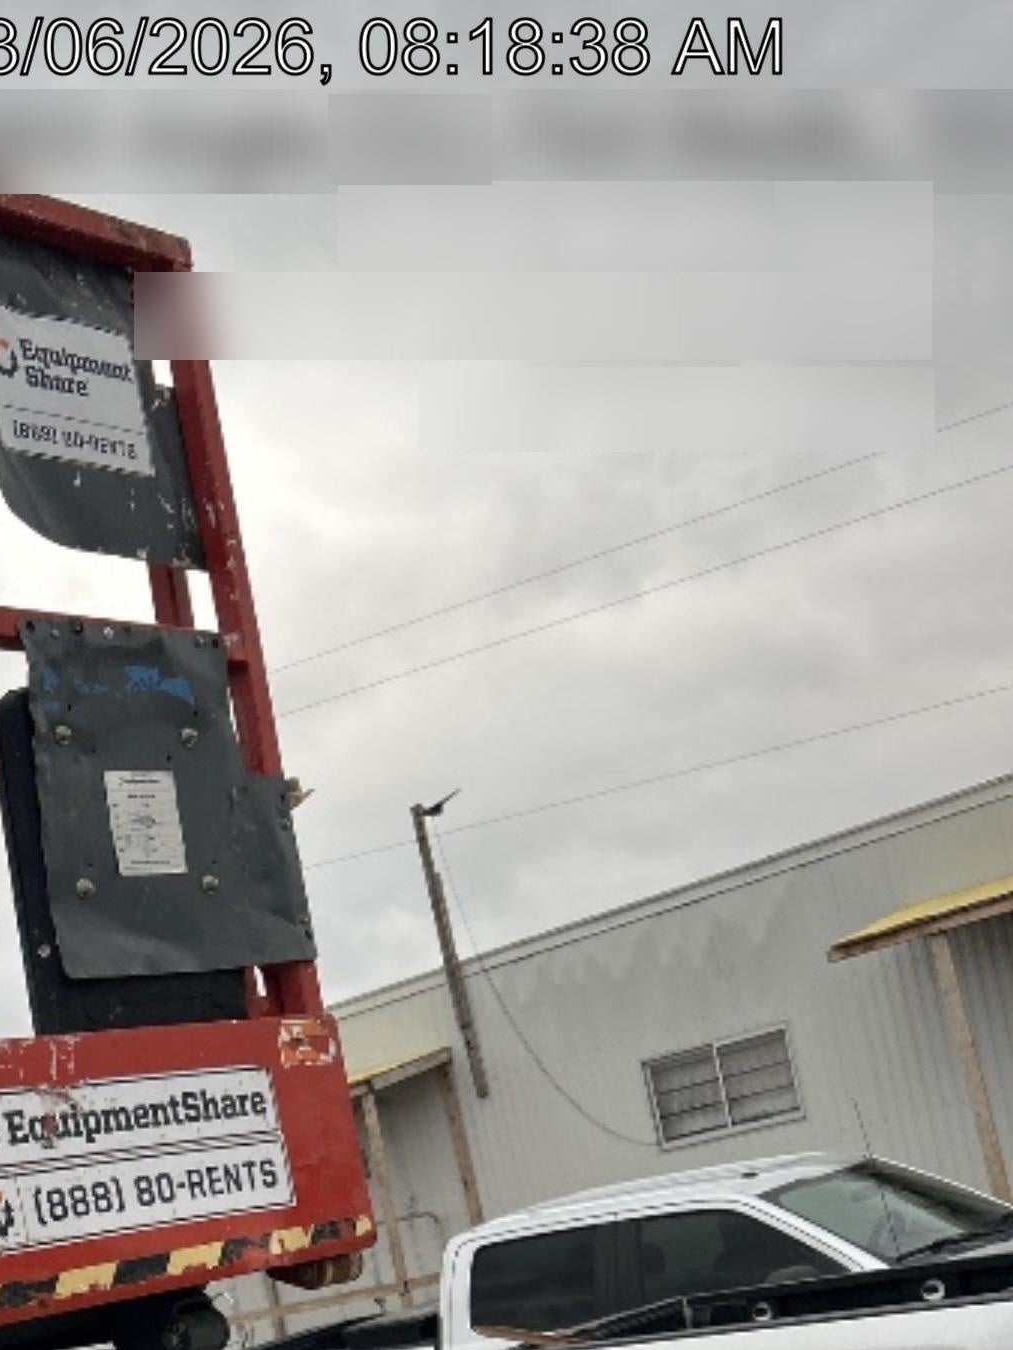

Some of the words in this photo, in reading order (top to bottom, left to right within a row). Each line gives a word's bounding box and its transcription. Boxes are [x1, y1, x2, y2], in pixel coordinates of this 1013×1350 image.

[24, 365, 89, 397] Share
[2, 1089, 267, 1150] EquipmentShare
[33, 1177, 126, 1225] (888)
[134, 1158, 278, 1207] 80-RENTS
